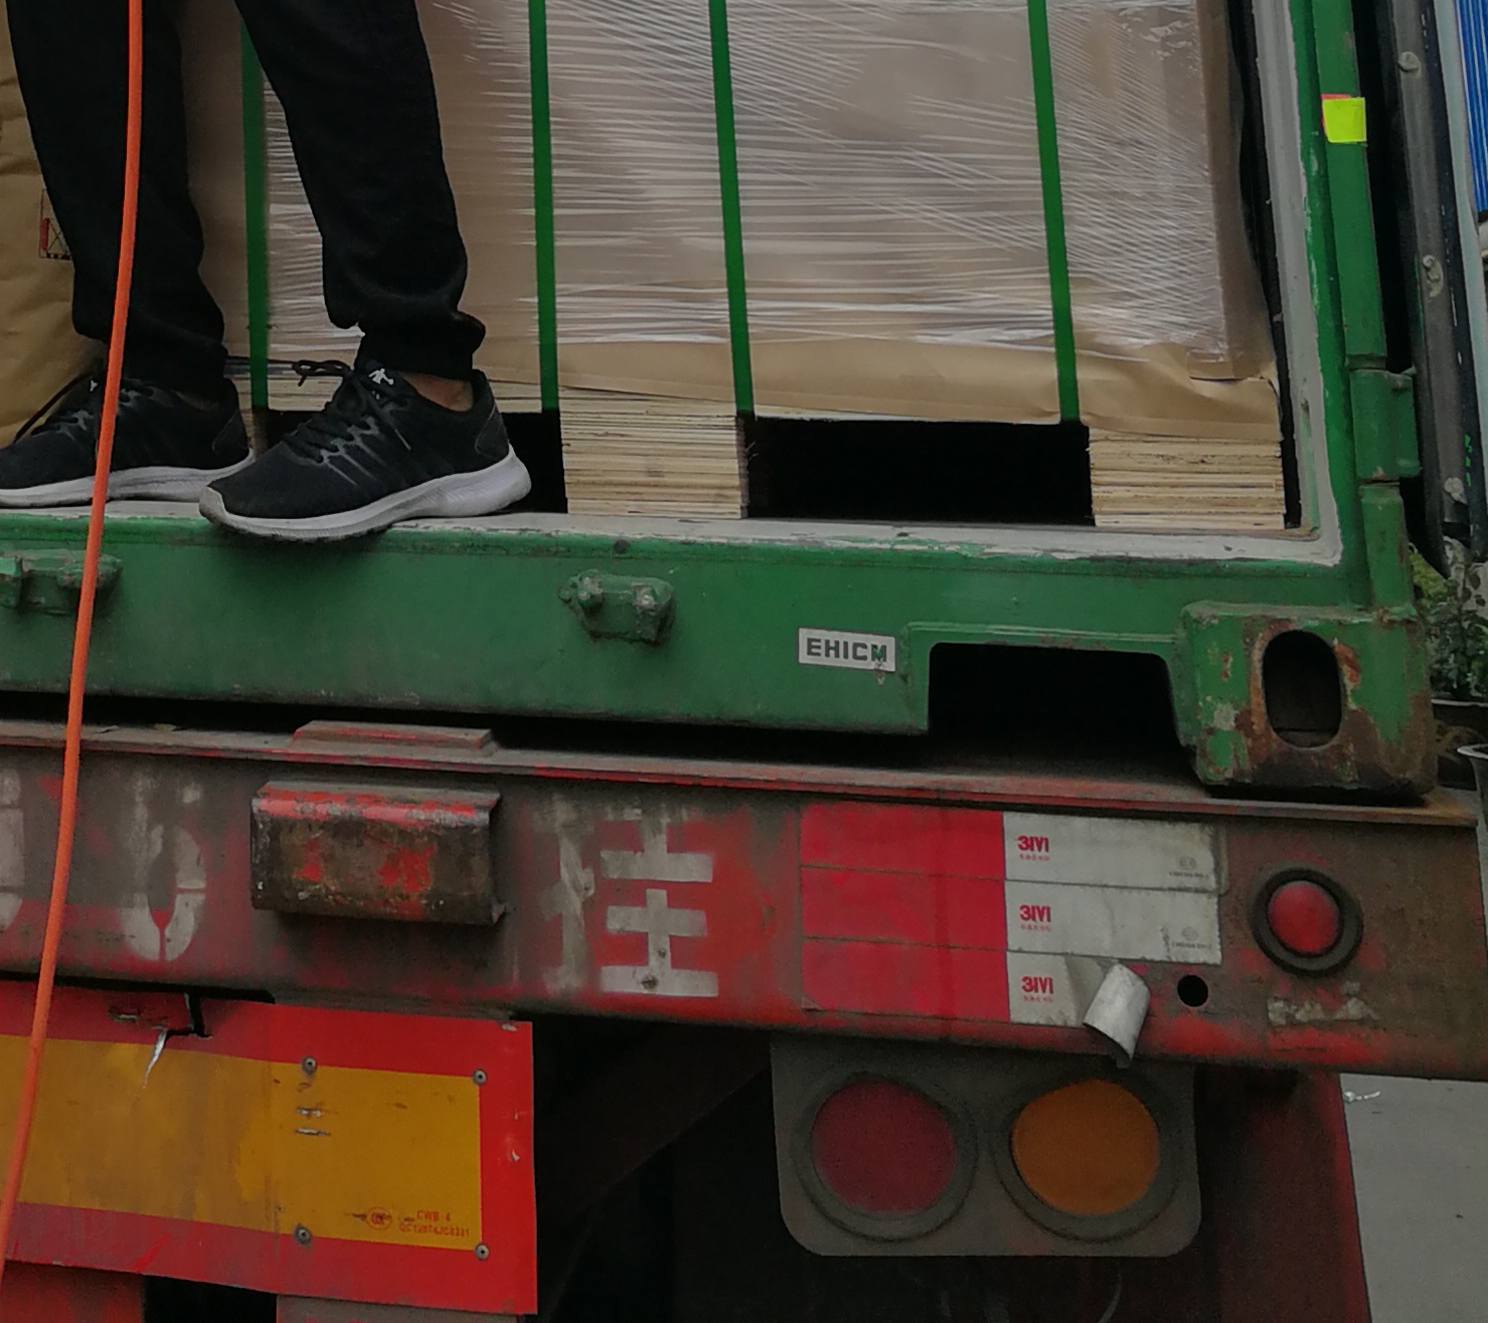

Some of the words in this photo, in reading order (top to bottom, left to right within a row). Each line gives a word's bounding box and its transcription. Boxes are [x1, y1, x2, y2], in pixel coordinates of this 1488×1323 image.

[1016, 835, 1050, 853] 3M
[532, 795, 720, 998] 挂
[1019, 904, 1052, 923] 3M
[1021, 975, 1054, 995] 3M
